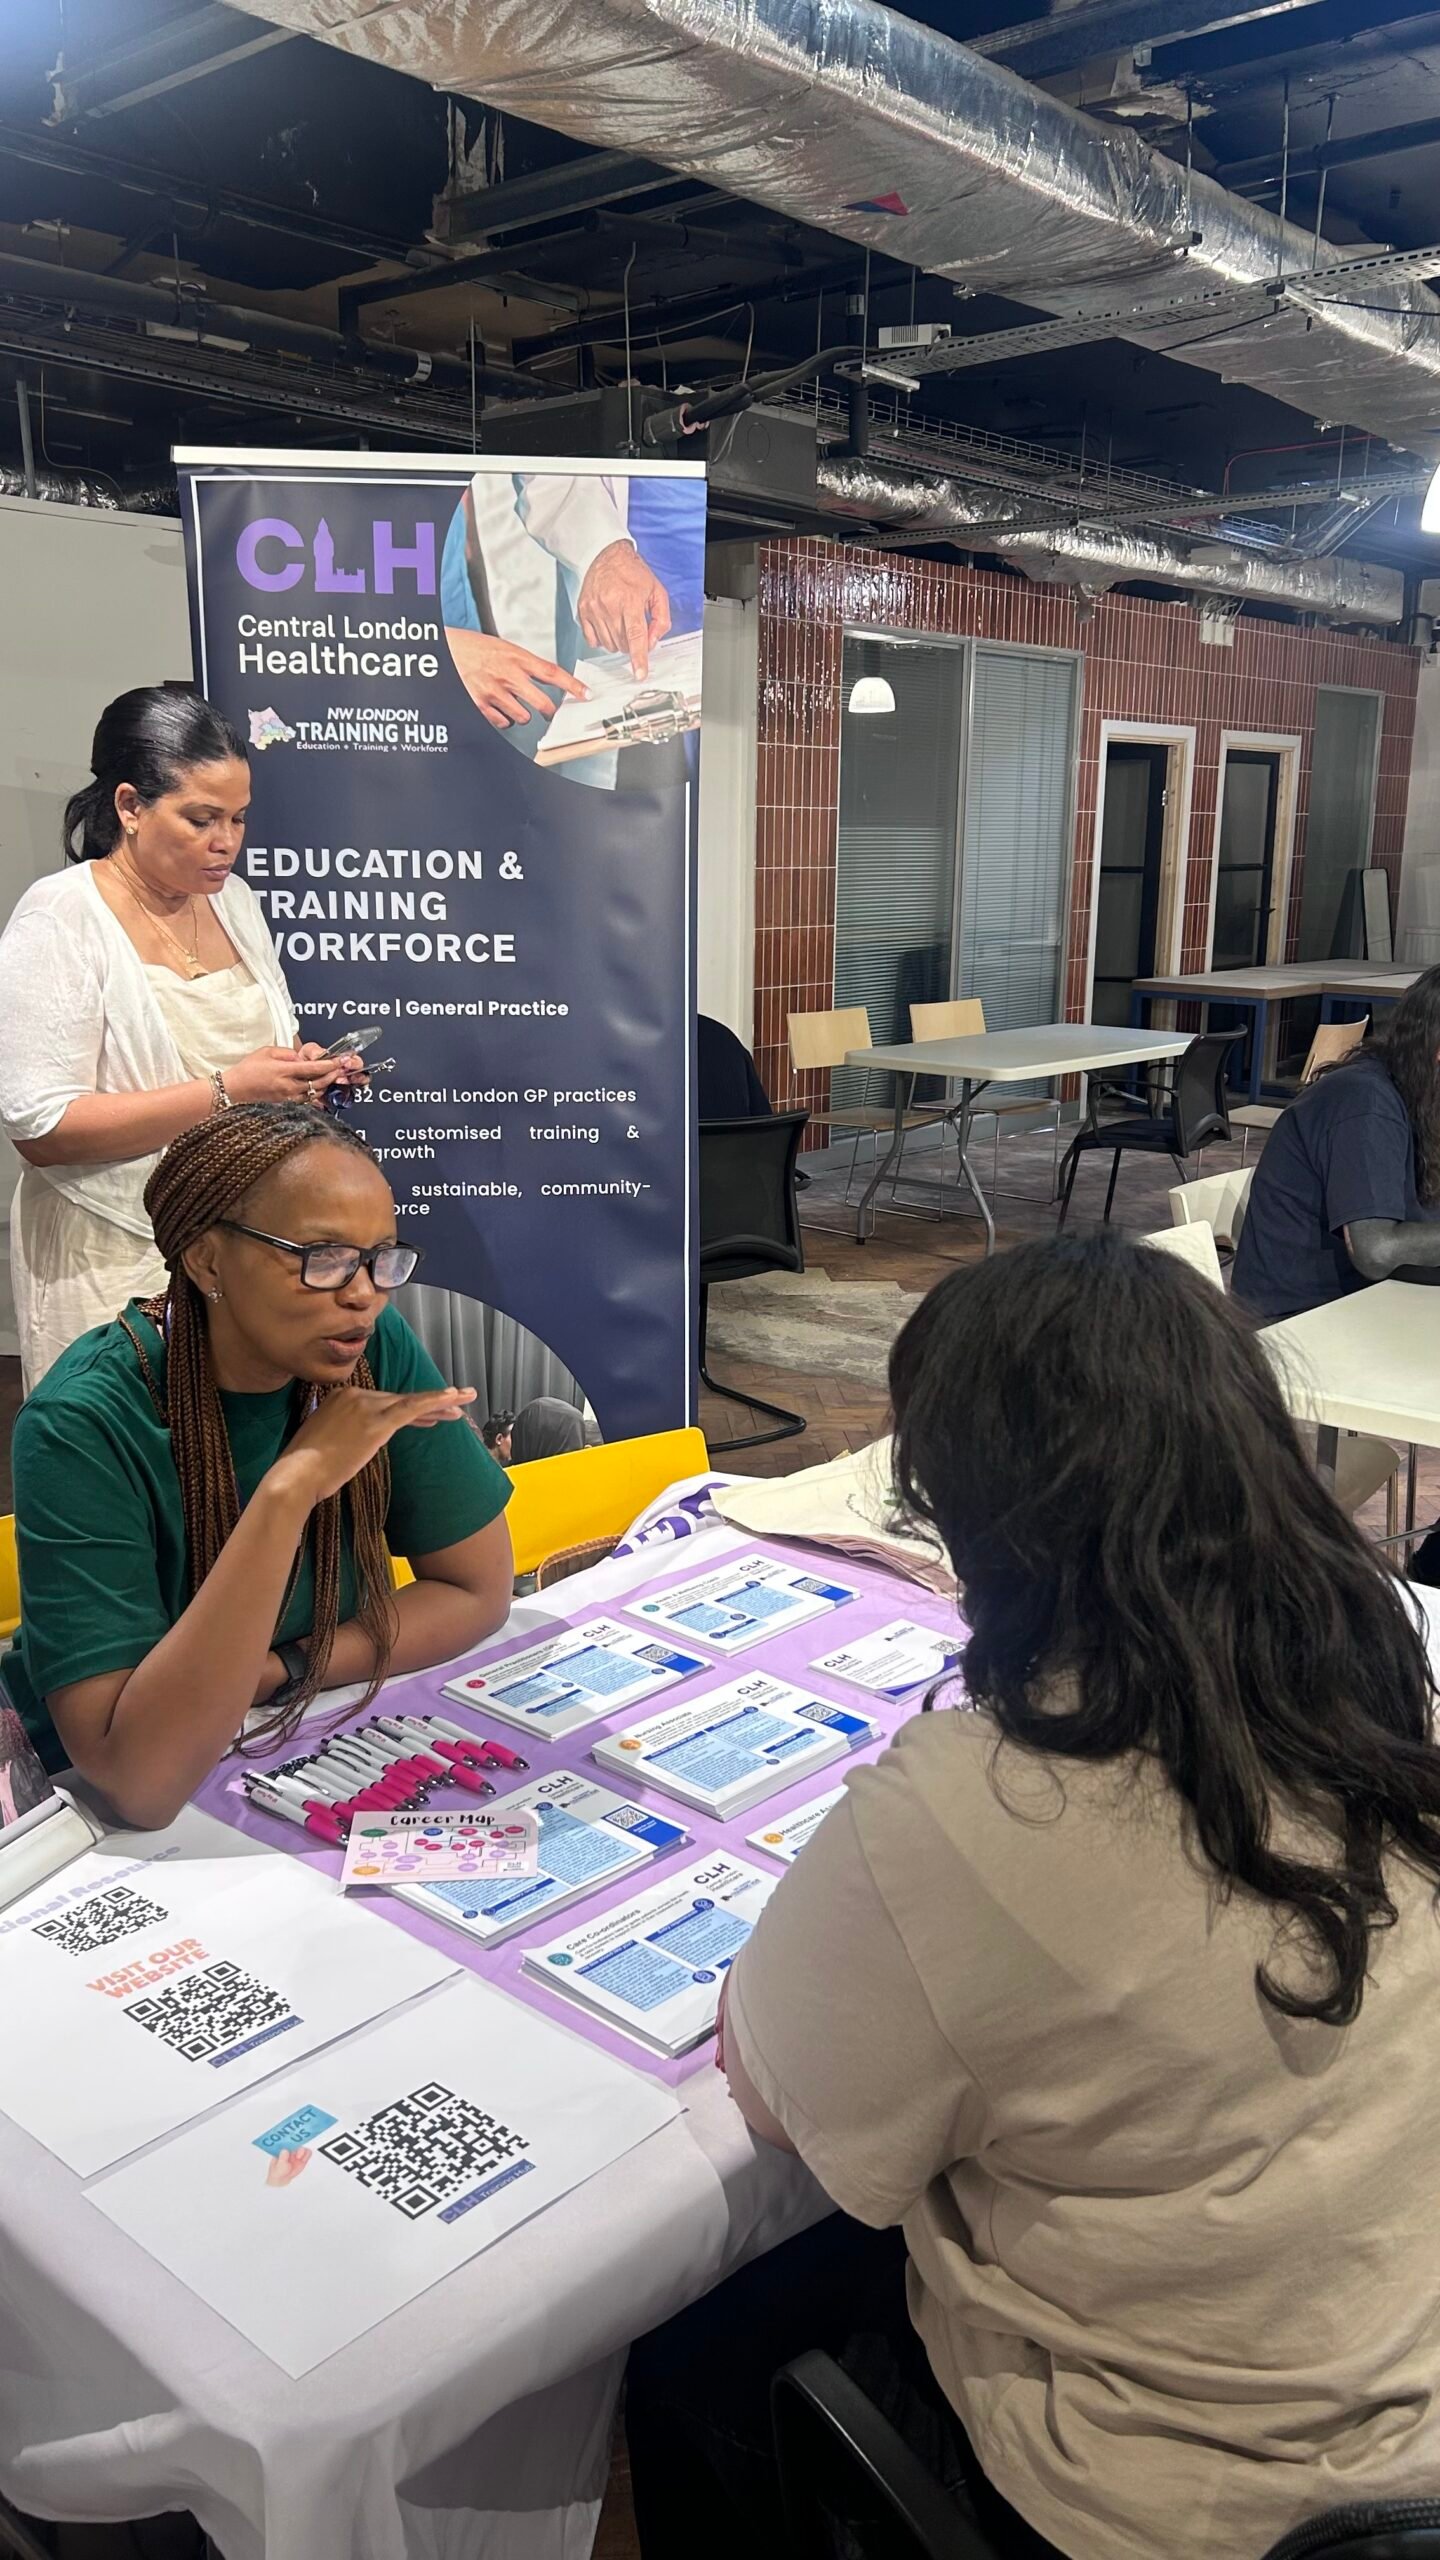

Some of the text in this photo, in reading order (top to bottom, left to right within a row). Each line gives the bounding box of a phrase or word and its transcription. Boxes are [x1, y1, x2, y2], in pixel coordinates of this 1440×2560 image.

[236, 517, 436, 594] CLH
[238, 614, 439, 640] Central London
[239, 642, 439, 677] Healthcare
[327, 707, 419, 722] NW LONDON
[296, 722, 448, 744] TRAINING HUB
[296, 741, 448, 753] Education Training Workforce
[246, 847, 524, 880] EDUCATION &
[342, 1001, 391, 1015] Care
[406, 1000, 483, 1016] General
[488, 1000, 569, 1016] Practice
[379, 1088, 447, 1103] Central
[452, 1088, 519, 1103] London
[524, 1088, 548, 1103] GP
[553, 1087, 637, 1107] practices
[395, 1125, 640, 1143] customised training &
[411, 1179, 651, 1199] sustainable, community-
[739, 1559, 765, 1571] CLH
[582, 1624, 611, 1638] CLH
[823, 1653, 852, 1668] CLH
[737, 1679, 768, 1695] CLH
[537, 1775, 574, 1794] CLH
[459, 1814, 496, 1826] Map
[693, 1862, 731, 1884] CLH
[566, 1909, 641, 1951] Care Co-ordinators
[85, 1938, 203, 1992] VISIT OUR
[104, 1948, 211, 1999] WEBSITE
[262, 2107, 317, 2148] CONTACT
[290, 2127, 312, 2145] US
[440, 2194, 480, 2221] CLH
[479, 2174, 517, 2198] Training
